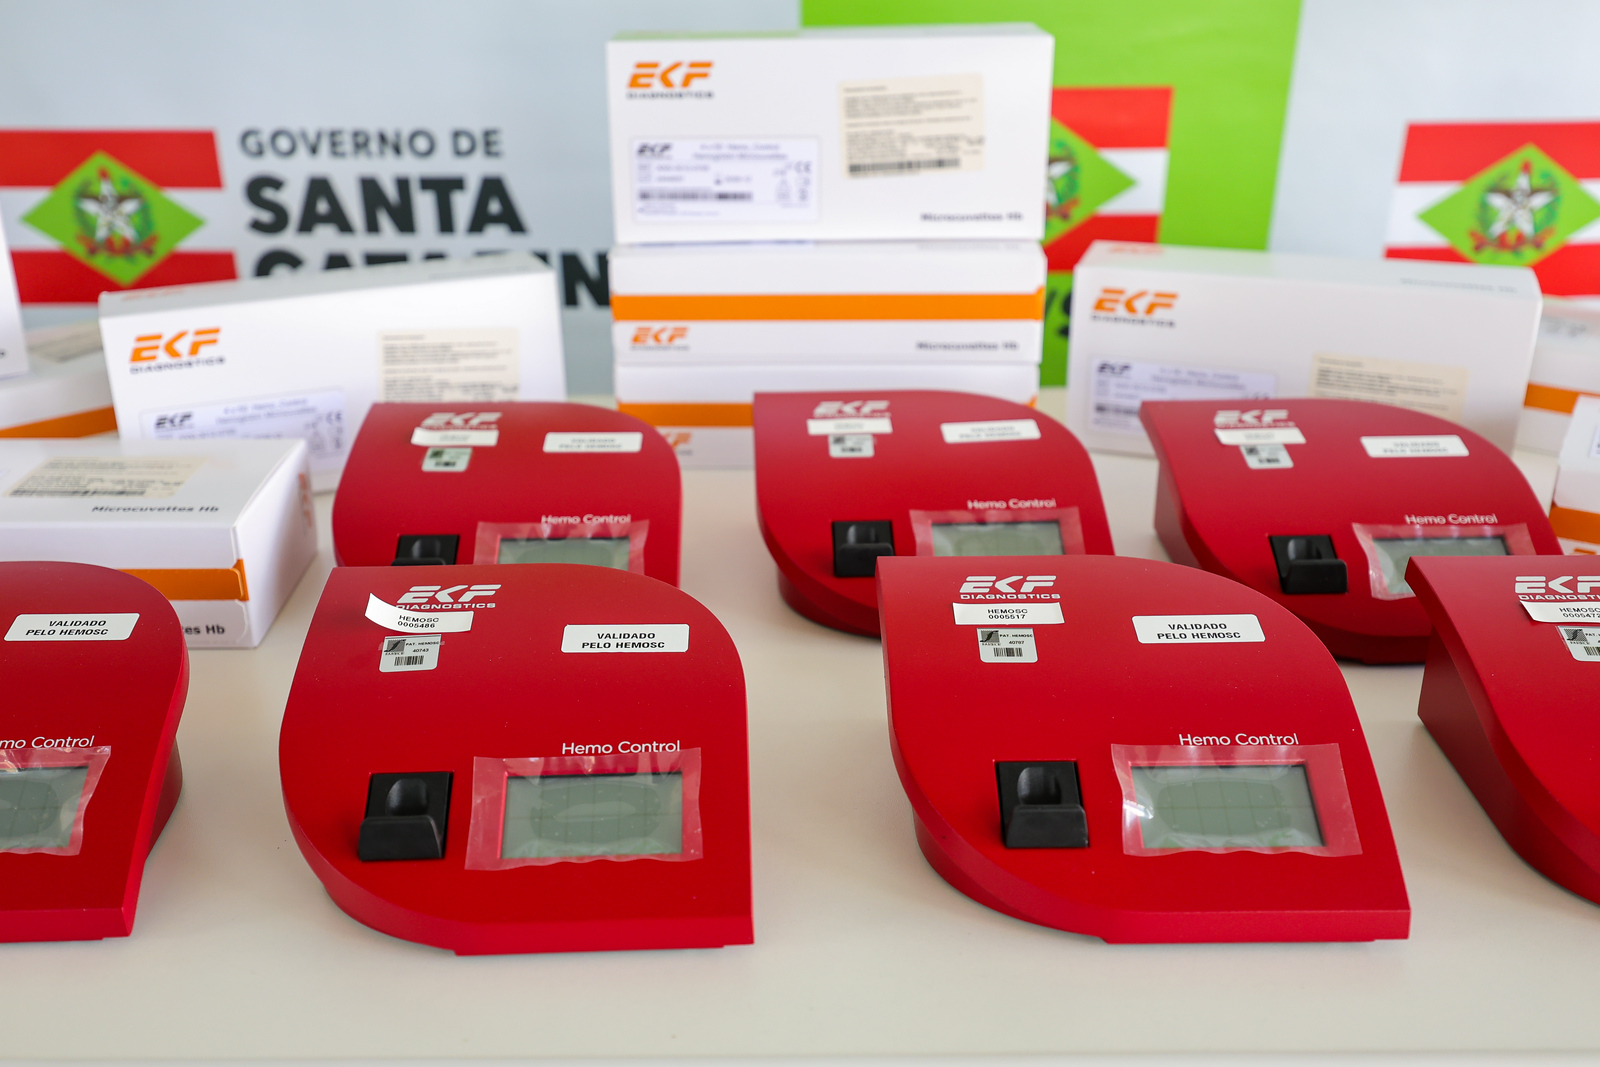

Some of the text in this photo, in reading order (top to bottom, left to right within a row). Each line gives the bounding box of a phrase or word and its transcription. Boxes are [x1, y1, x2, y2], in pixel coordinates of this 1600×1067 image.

[627, 61, 713, 88] EKF
[241, 128, 503, 159] GOVERNO DE
[245, 175, 528, 235] SANTA
[1093, 288, 1179, 315] EKF
[632, 327, 689, 344] EKF
[130, 327, 221, 362] EKF
[813, 400, 890, 414] EKF
[421, 412, 502, 426] EKF
[1214, 409, 1289, 424] EKF
[968, 498, 1056, 509] Hemo Control
[541, 514, 631, 524] Hemo Control
[1405, 513, 1498, 524] Hemo Control
[959, 575, 1057, 593] EKF
[396, 584, 502, 603] EKF
[395, 602, 496, 610] DIAGNOSTICS
[397, 620, 436, 628] 0005486
[398, 614, 440, 623] HEMOSC
[59, 628, 109, 636] HEMOSC
[205, 624, 225, 635] Hb
[1168, 622, 1228, 631] VALIDADO
[596, 632, 656, 640] VALIDADO
[1157, 631, 1242, 641] PELO HEMOSC
[582, 641, 665, 649] PELO HEMOSC
[31, 735, 95, 749] Control
[1179, 733, 1299, 747] Hemo Control
[561, 740, 681, 755] Hemo Control
